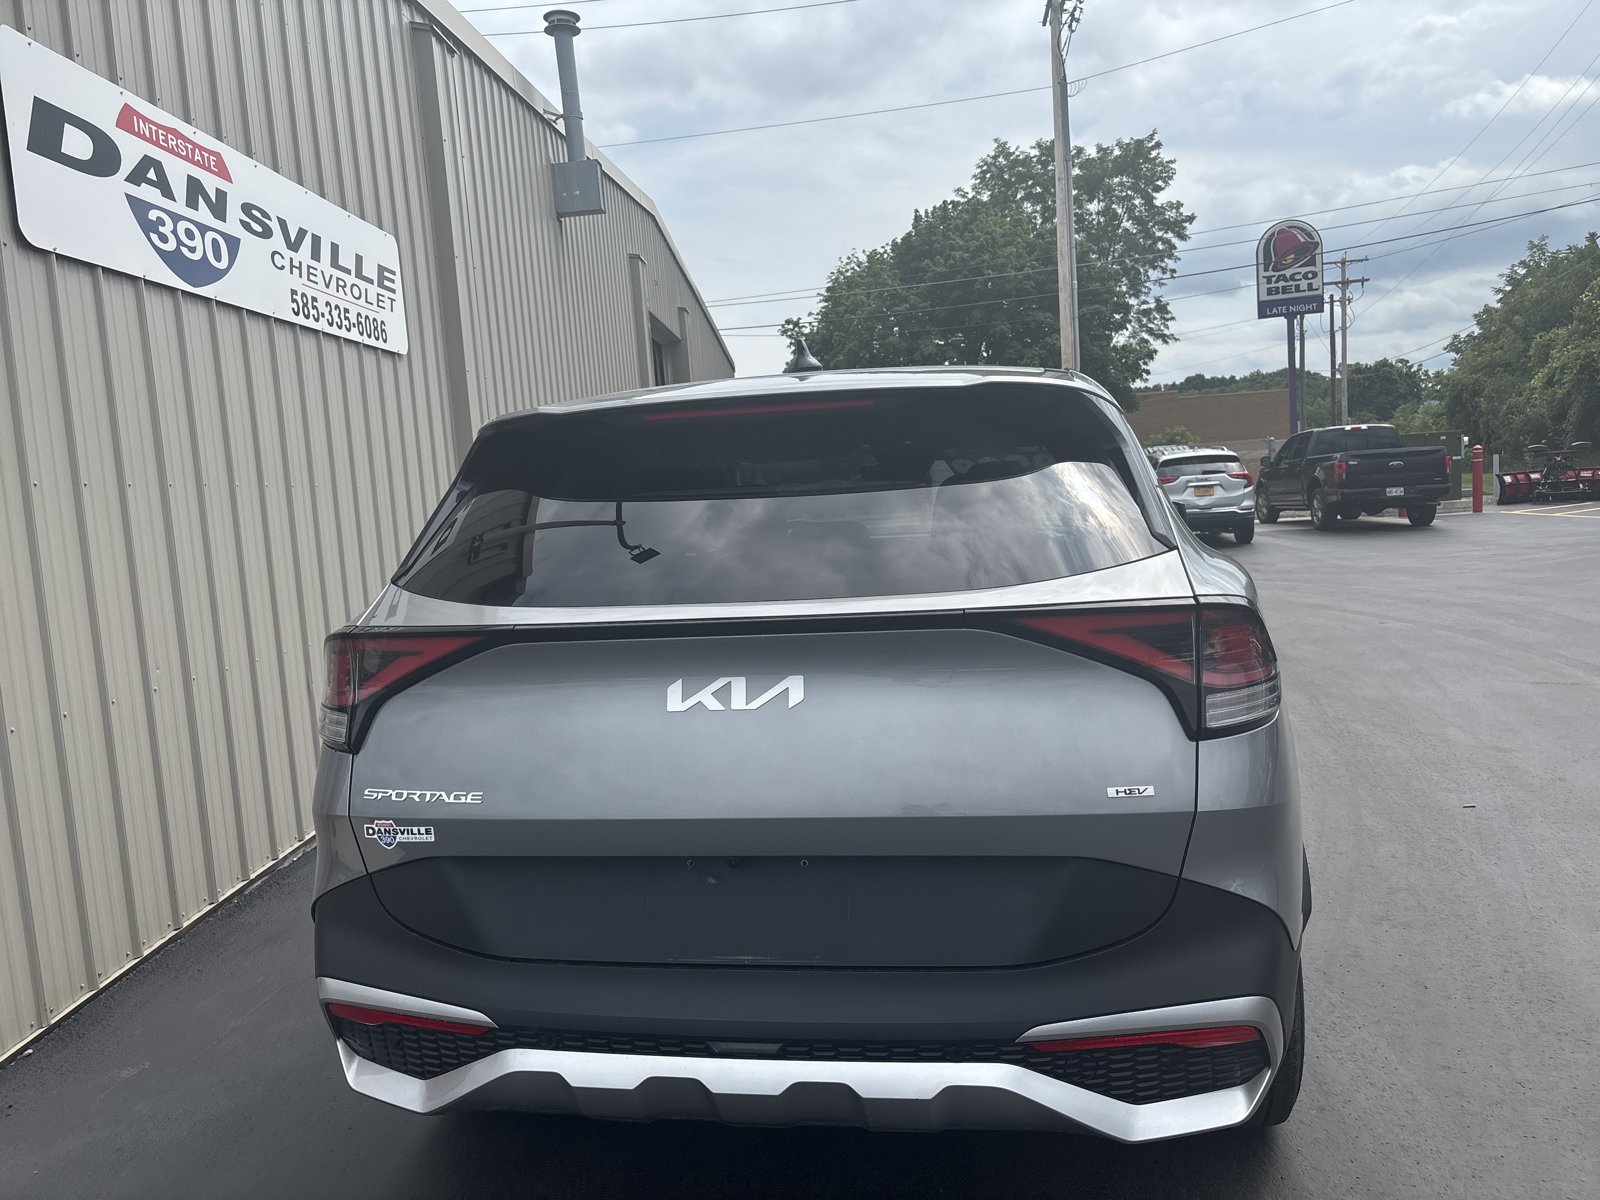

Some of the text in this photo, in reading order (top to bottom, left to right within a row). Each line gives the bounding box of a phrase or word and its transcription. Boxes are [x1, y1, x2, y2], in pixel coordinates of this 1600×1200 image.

[133, 115, 219, 173] INTERSTATE
[26, 95, 397, 295] DANSVILLE
[146, 208, 230, 271] 390
[270, 250, 397, 313] CHEVROLET
[1262, 270, 1319, 285] TACO
[1266, 282, 1320, 297] BELL
[290, 288, 388, 344] 585-335-6086
[1266, 303, 1318, 315] LATE NIGHT
[666, 675, 805, 712] KIA
[363, 788, 484, 804] SPORTAGE
[1115, 787, 1149, 796] HEV
[365, 826, 433, 836] DANSVILLE
[380, 836, 395, 844] 390
